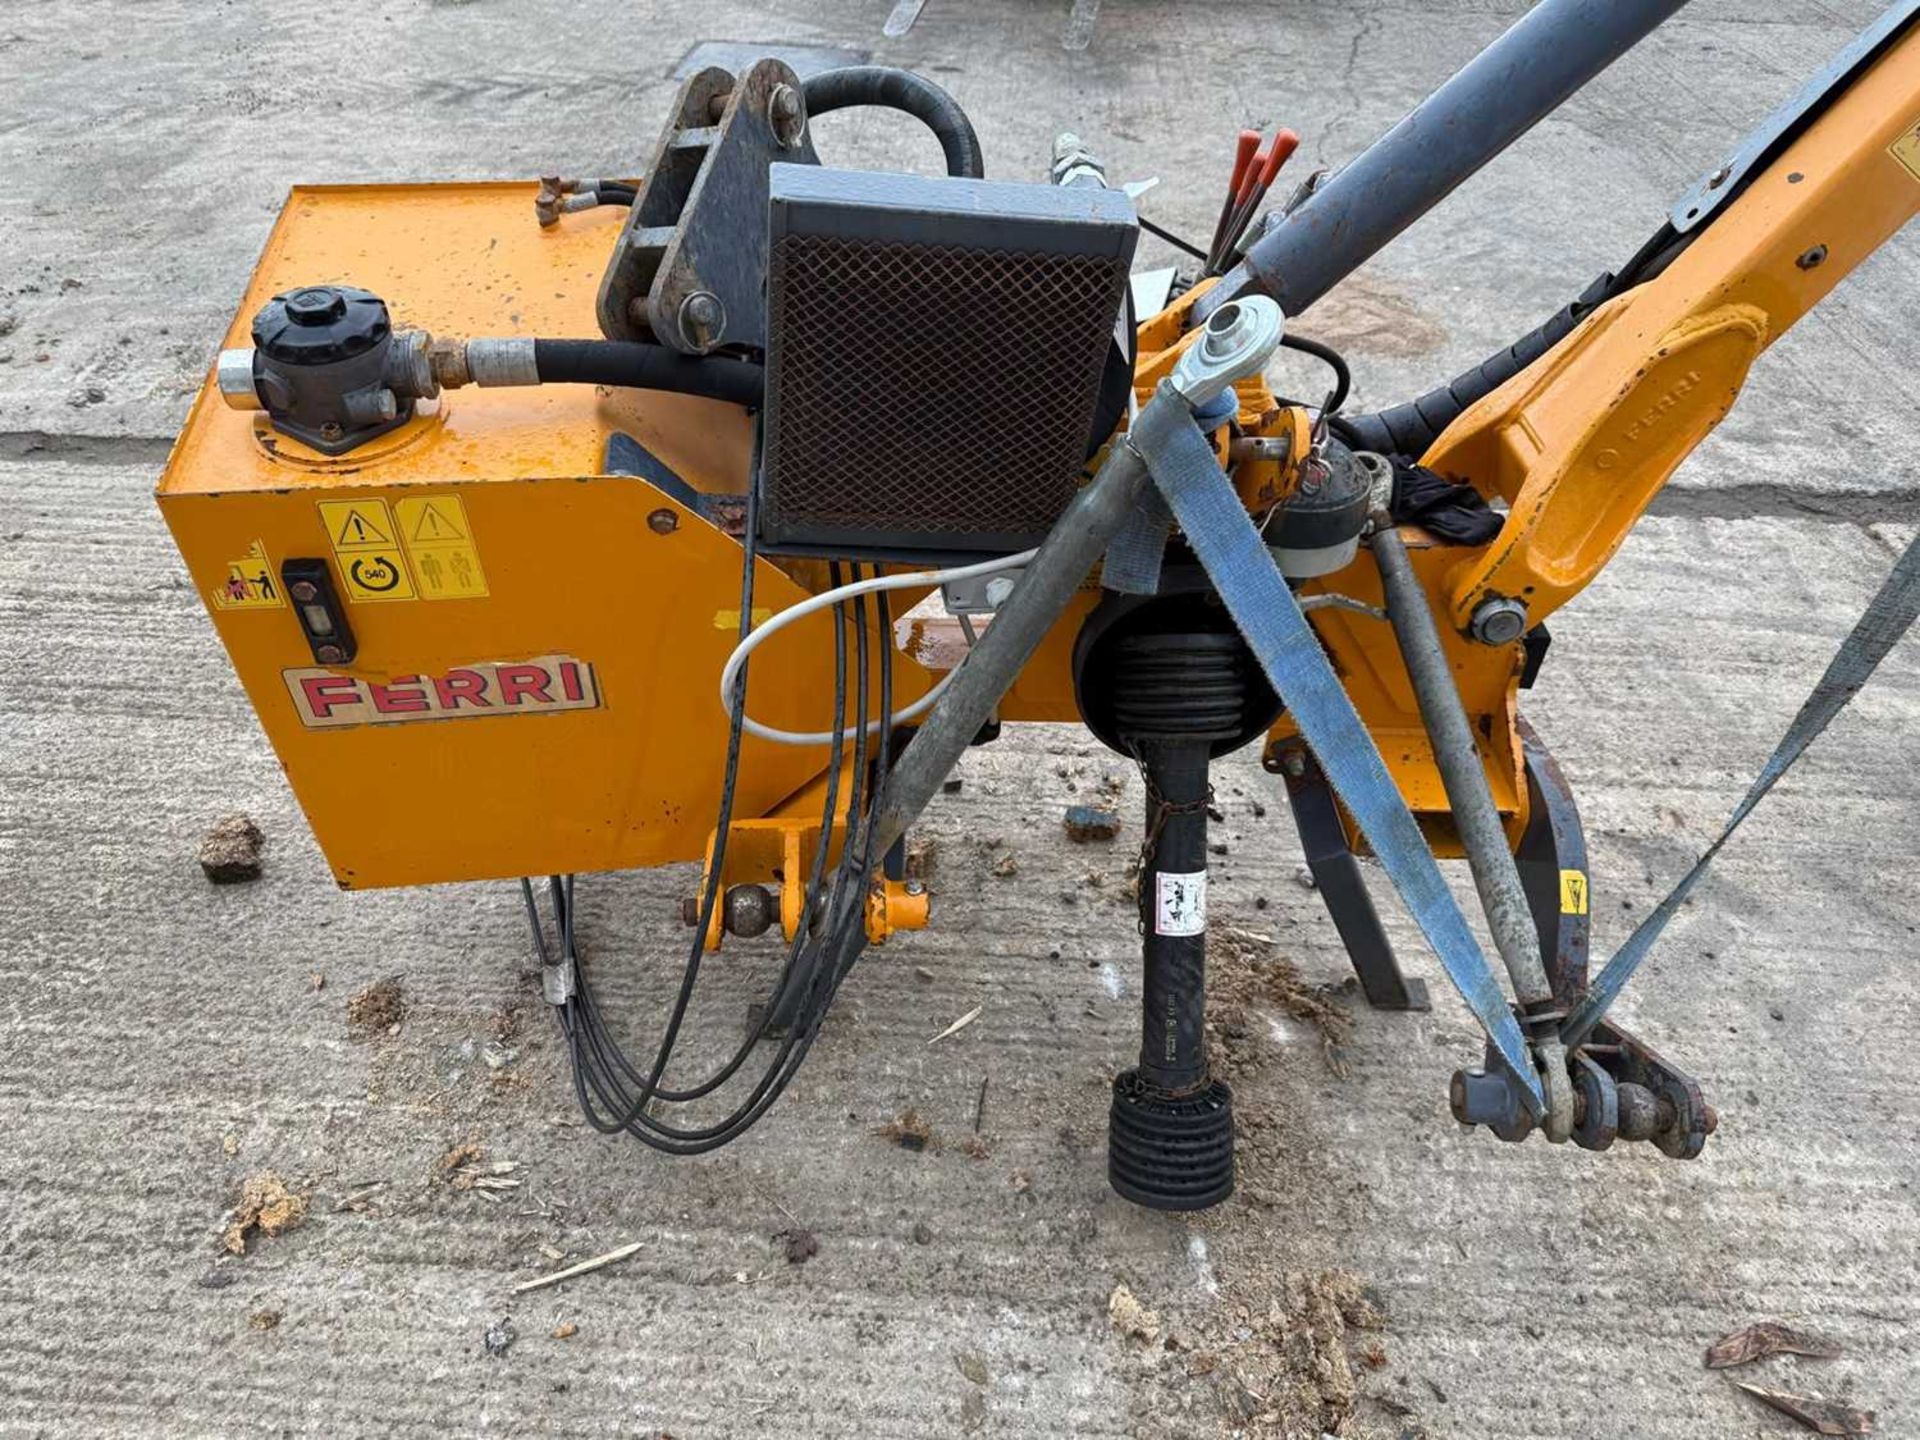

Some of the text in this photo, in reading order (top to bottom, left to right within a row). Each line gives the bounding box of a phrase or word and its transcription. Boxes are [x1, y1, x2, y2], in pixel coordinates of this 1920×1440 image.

[1626, 371, 1701, 441] FERRI
[364, 569, 386, 580] 540
[301, 663, 585, 717] FERRI
